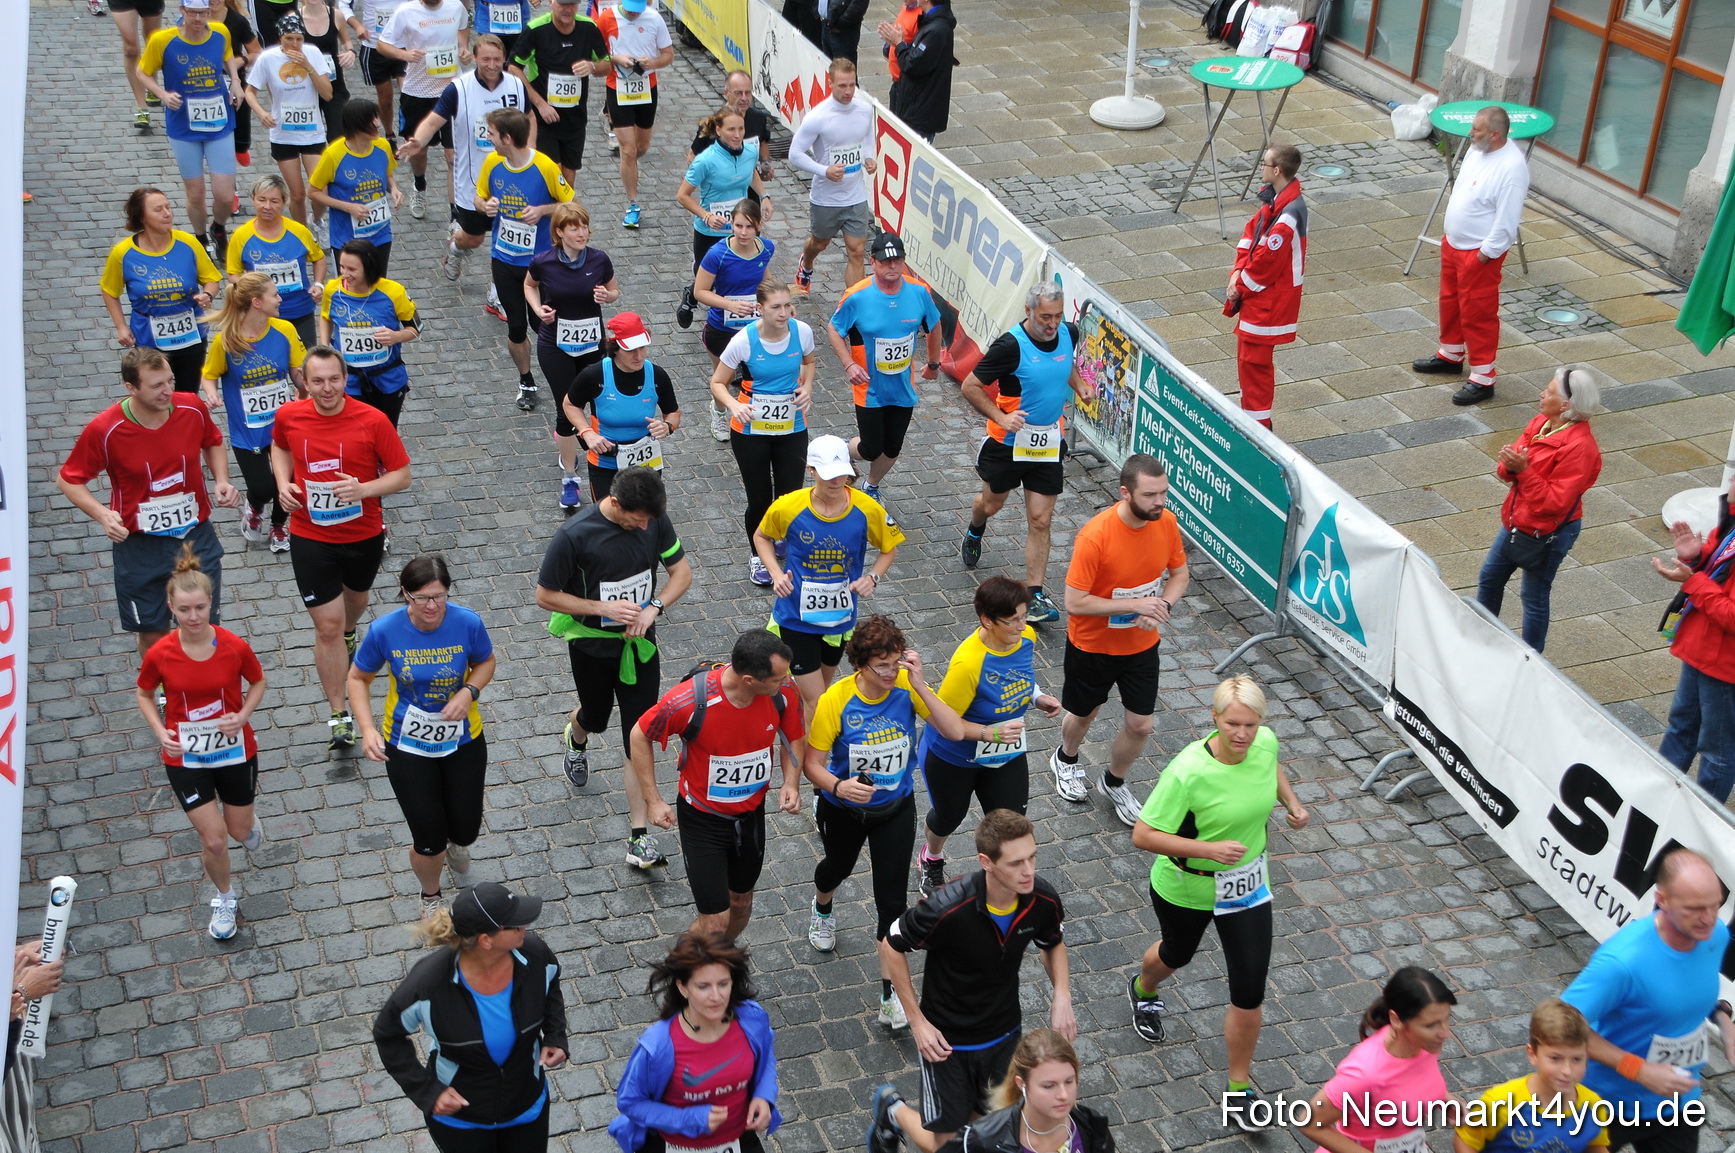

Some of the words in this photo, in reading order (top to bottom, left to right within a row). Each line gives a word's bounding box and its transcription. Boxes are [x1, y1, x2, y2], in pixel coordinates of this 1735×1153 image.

[492, 10, 519, 23] 2106
[433, 52, 454, 67] 154
[555, 83, 577, 95] 296
[624, 80, 644, 94] 128
[501, 94, 518, 108] 13
[193, 105, 224, 121] 2174
[284, 111, 314, 124] 2091
[833, 150, 861, 166] 2804
[500, 226, 531, 247] 2916
[270, 269, 296, 285] 611
[156, 316, 193, 337] 2443
[561, 327, 598, 343] 2424
[344, 337, 384, 353] 2498
[884, 344, 910, 361] 325
[248, 390, 287, 413] 2675
[761, 404, 789, 420] 242
[1163, 385, 1231, 453] Event-Leit-Systeme
[1029, 432, 1048, 448] 98
[626, 445, 653, 467] 243
[1141, 406, 1172, 447] Mehr
[1173, 434, 1232, 502] Sicherheit
[1175, 466, 1214, 515] Event!
[311, 492, 353, 510] 272
[148, 504, 192, 531] 2515
[321, 510, 351, 520] Andreas
[1164, 496, 1185, 520] ervice
[1185, 514, 1202, 538] Line:
[1203, 530, 1225, 559] 09181
[1226, 552, 1246, 578] 6352
[806, 590, 849, 611] 3316
[1320, 621, 1345, 646] Service
[1345, 641, 1367, 663] GmbH
[391, 649, 405, 659] 10.
[405, 644, 465, 659] NEUMARKTER
[403, 654, 454, 666] STADTLAUF
[407, 720, 459, 743] 2287
[197, 751, 231, 763] Melanie
[711, 758, 733, 767] PARTL
[733, 755, 762, 767] Neumarkt
[856, 750, 903, 773] 2471
[715, 761, 766, 785] 2470
[1438, 745, 1455, 767] die
[1455, 760, 1505, 817] verbinden
[728, 786, 751, 797] Frank
[1222, 866, 1263, 900] 2601
[1536, 835, 1636, 930] stadtw
[682, 1090, 712, 1102] JUST
[715, 1084, 733, 1096] DO
